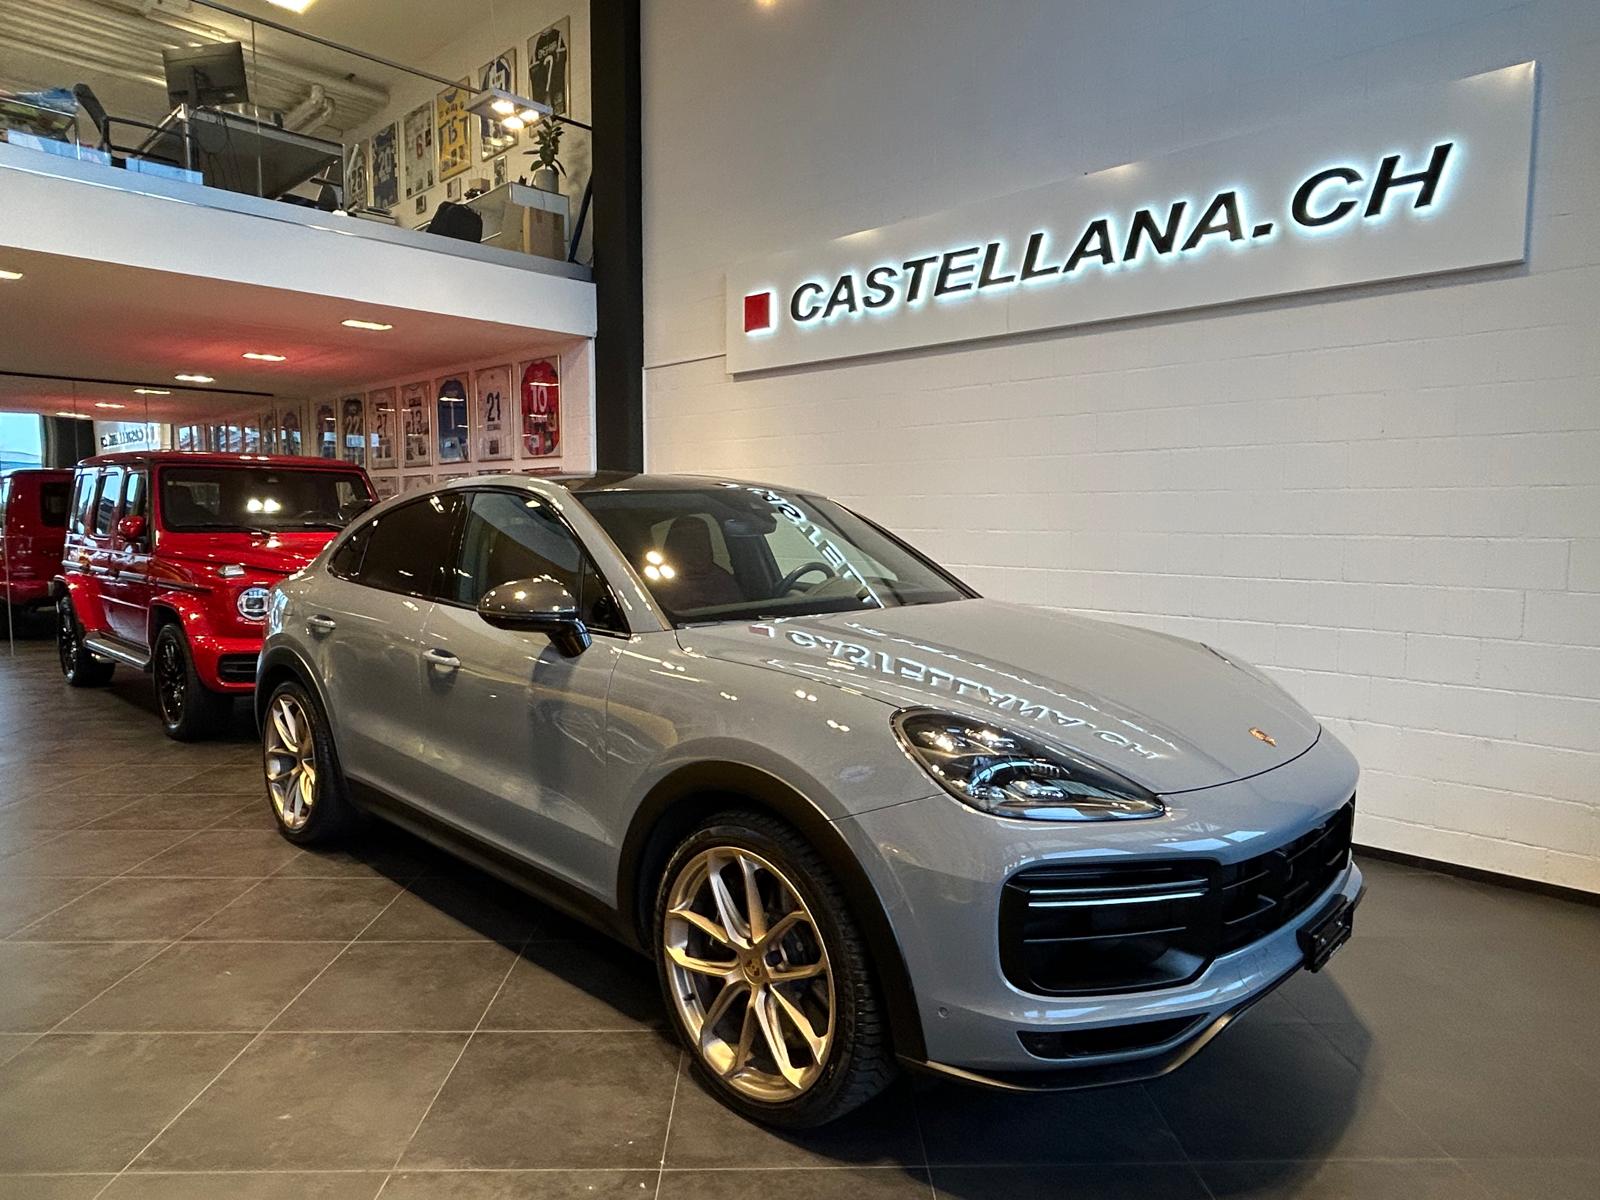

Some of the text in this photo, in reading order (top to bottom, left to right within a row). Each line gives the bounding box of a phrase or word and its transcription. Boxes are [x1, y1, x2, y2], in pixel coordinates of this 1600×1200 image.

[543, 55, 554, 92] 7
[790, 142, 1453, 323] CASTELLANA.CH
[486, 391, 501, 422] 21
[530, 384, 548, 413] 10
[411, 409, 422, 435] 13
